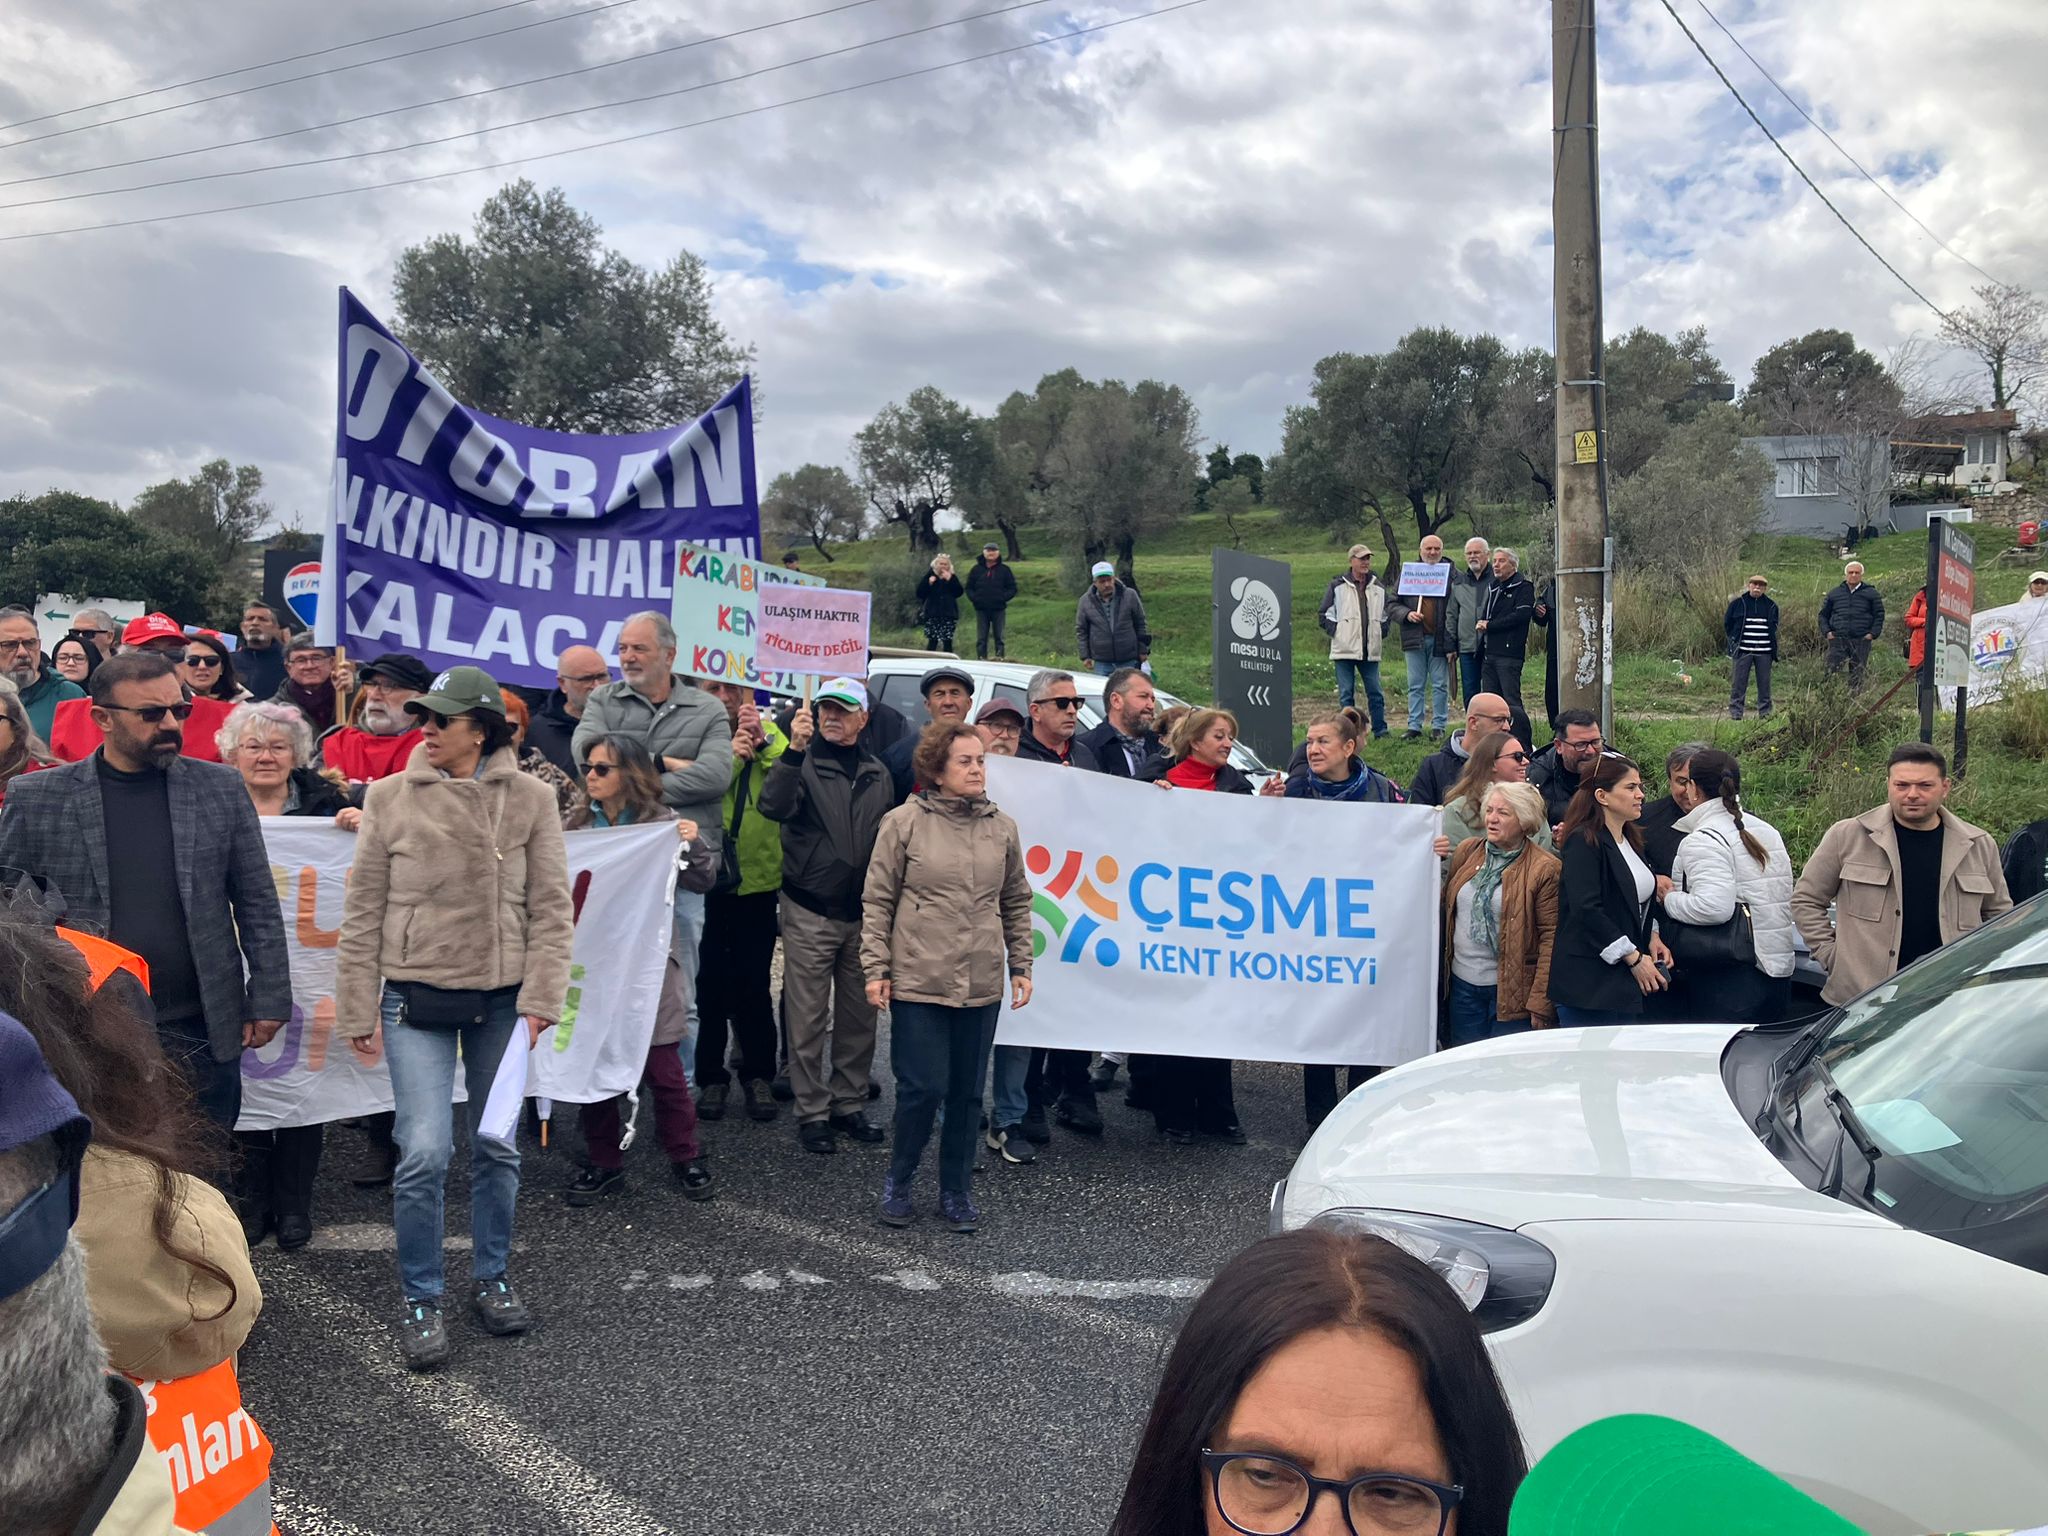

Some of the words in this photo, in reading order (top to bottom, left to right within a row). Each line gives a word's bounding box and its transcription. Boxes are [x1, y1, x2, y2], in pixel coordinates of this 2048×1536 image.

[292, 579, 320, 590] RE/M
[718, 604, 756, 637] KEN
[765, 605, 812, 621] ULAŞIM
[814, 609, 860, 623] HAKTIR
[765, 632, 821, 656] TİCARET
[823, 638, 862, 657] DEĞİL
[1230, 642, 1258, 657] mesa
[1260, 648, 1282, 661] URLA
[1129, 862, 1375, 940] ÇEŞME
[1139, 942, 1221, 977] KENT
